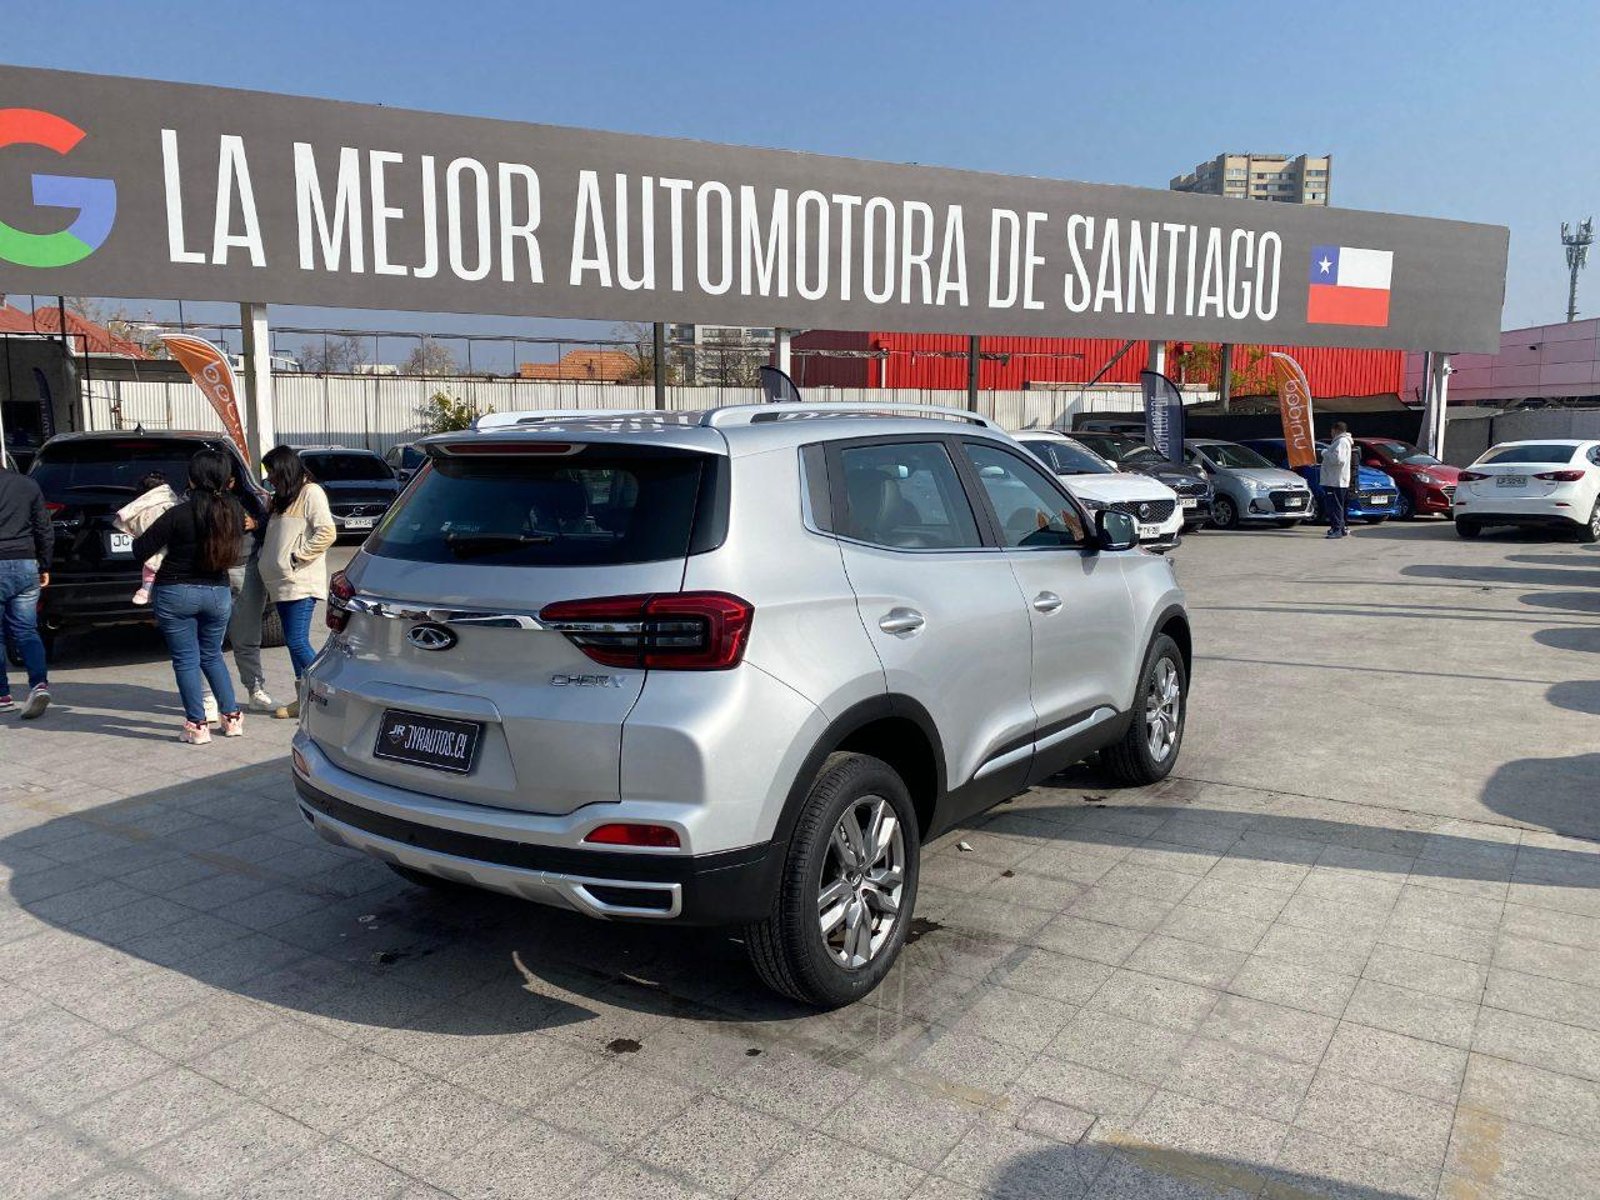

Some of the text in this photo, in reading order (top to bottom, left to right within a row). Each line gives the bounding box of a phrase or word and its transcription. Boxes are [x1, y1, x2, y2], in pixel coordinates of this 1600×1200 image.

[160, 128, 1282, 322] LA MEJOR AUTOMOTORA DE SANTIAGO
[551, 674, 626, 689] CHERY
[404, 725, 468, 759] JYRAUTOS.CL
